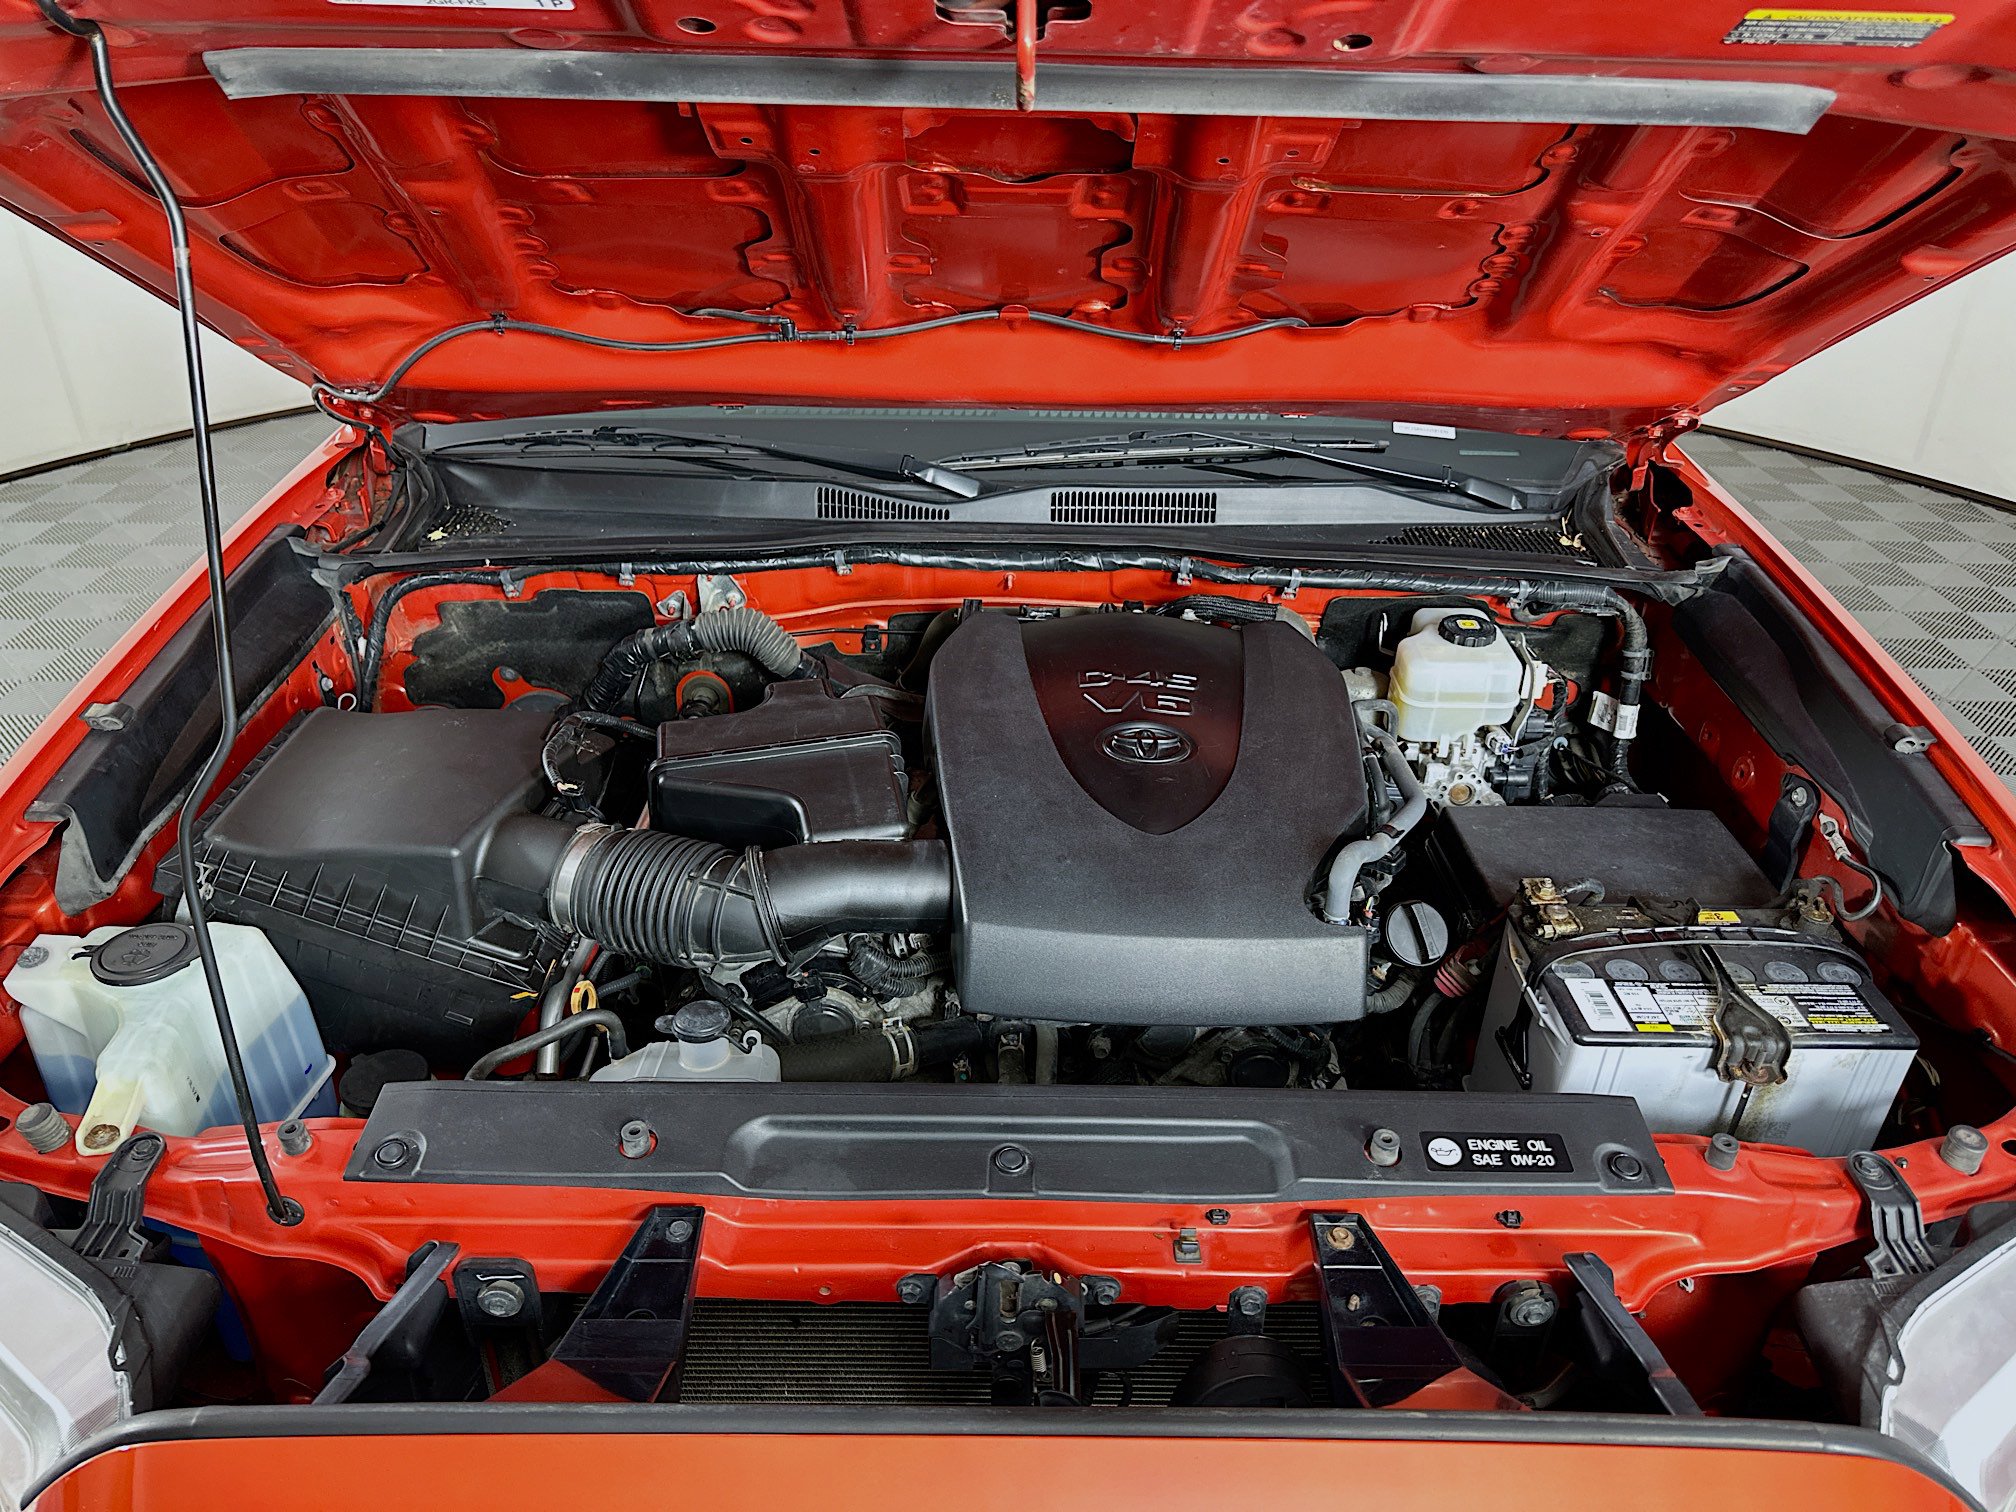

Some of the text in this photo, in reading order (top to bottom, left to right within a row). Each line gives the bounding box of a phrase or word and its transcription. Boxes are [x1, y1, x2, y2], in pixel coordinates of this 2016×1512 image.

[1078, 671, 1200, 691] D-4S
[1083, 690, 1194, 716] V6
[1466, 1138, 1552, 1152] ENGINE OIL
[1472, 1153, 1556, 1167] SAE 0W-20
